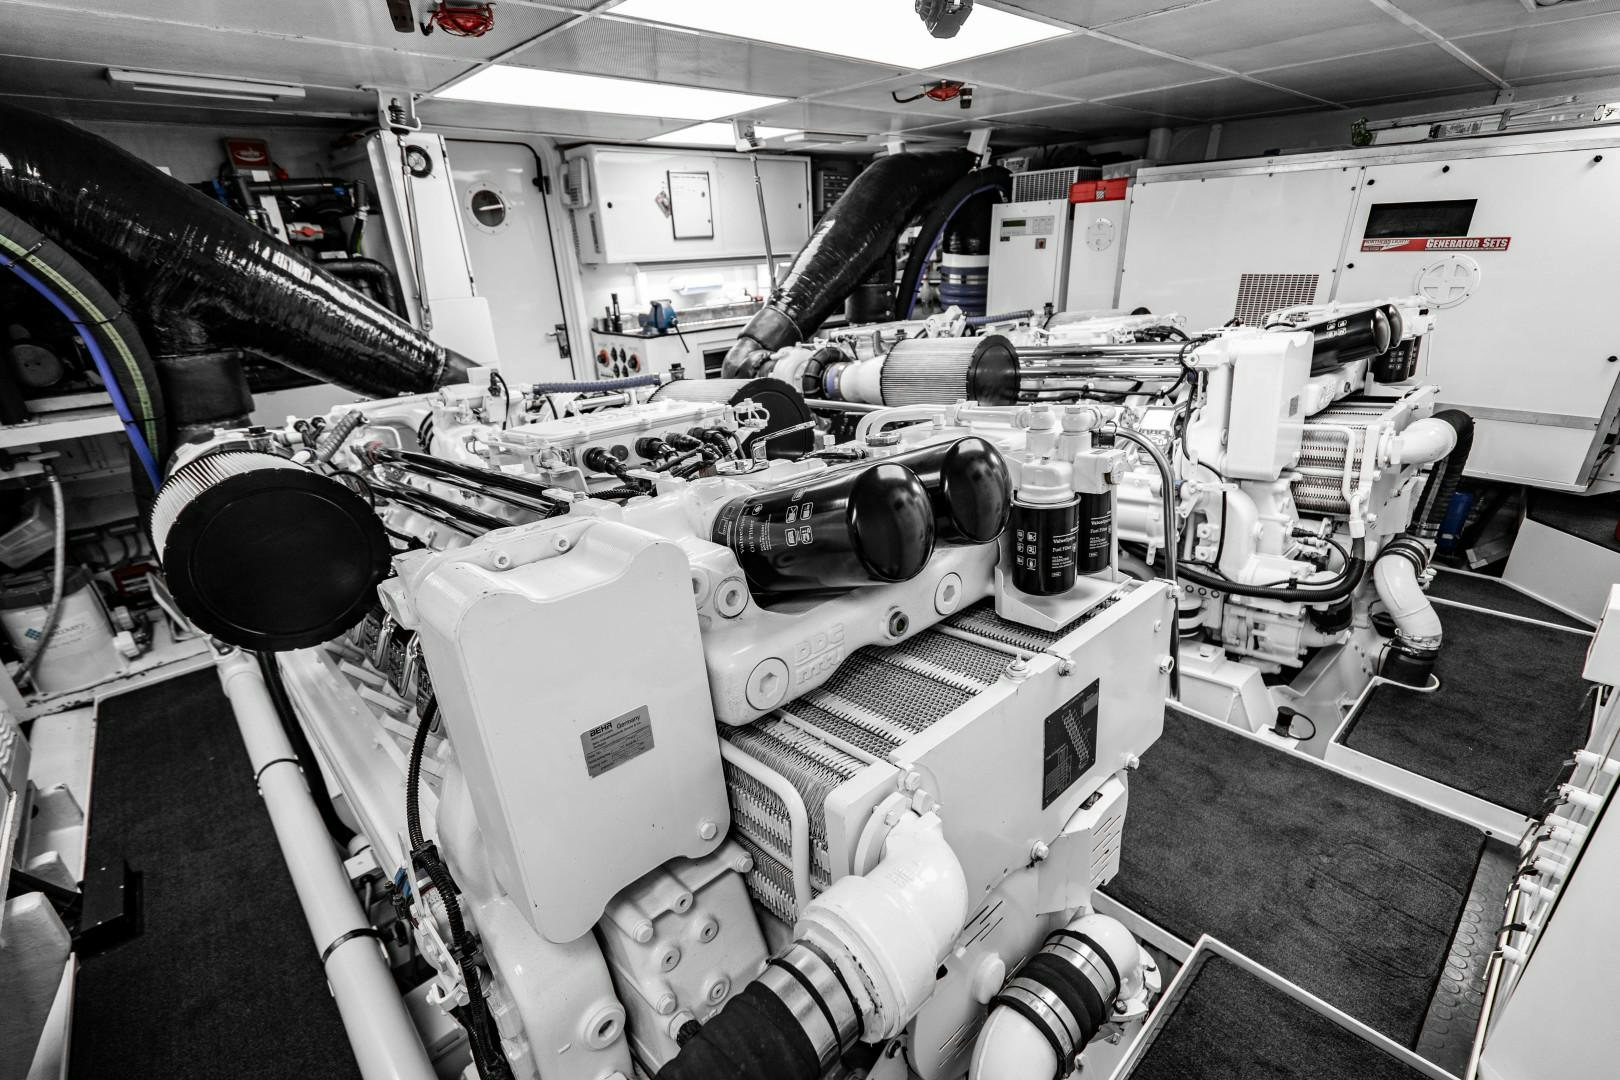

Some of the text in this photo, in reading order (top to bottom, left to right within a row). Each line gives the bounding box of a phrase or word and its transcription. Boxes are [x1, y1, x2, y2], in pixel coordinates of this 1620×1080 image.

[1426, 238, 1507, 249] GENERATOR SETS
[590, 722, 612, 737] BEHR
